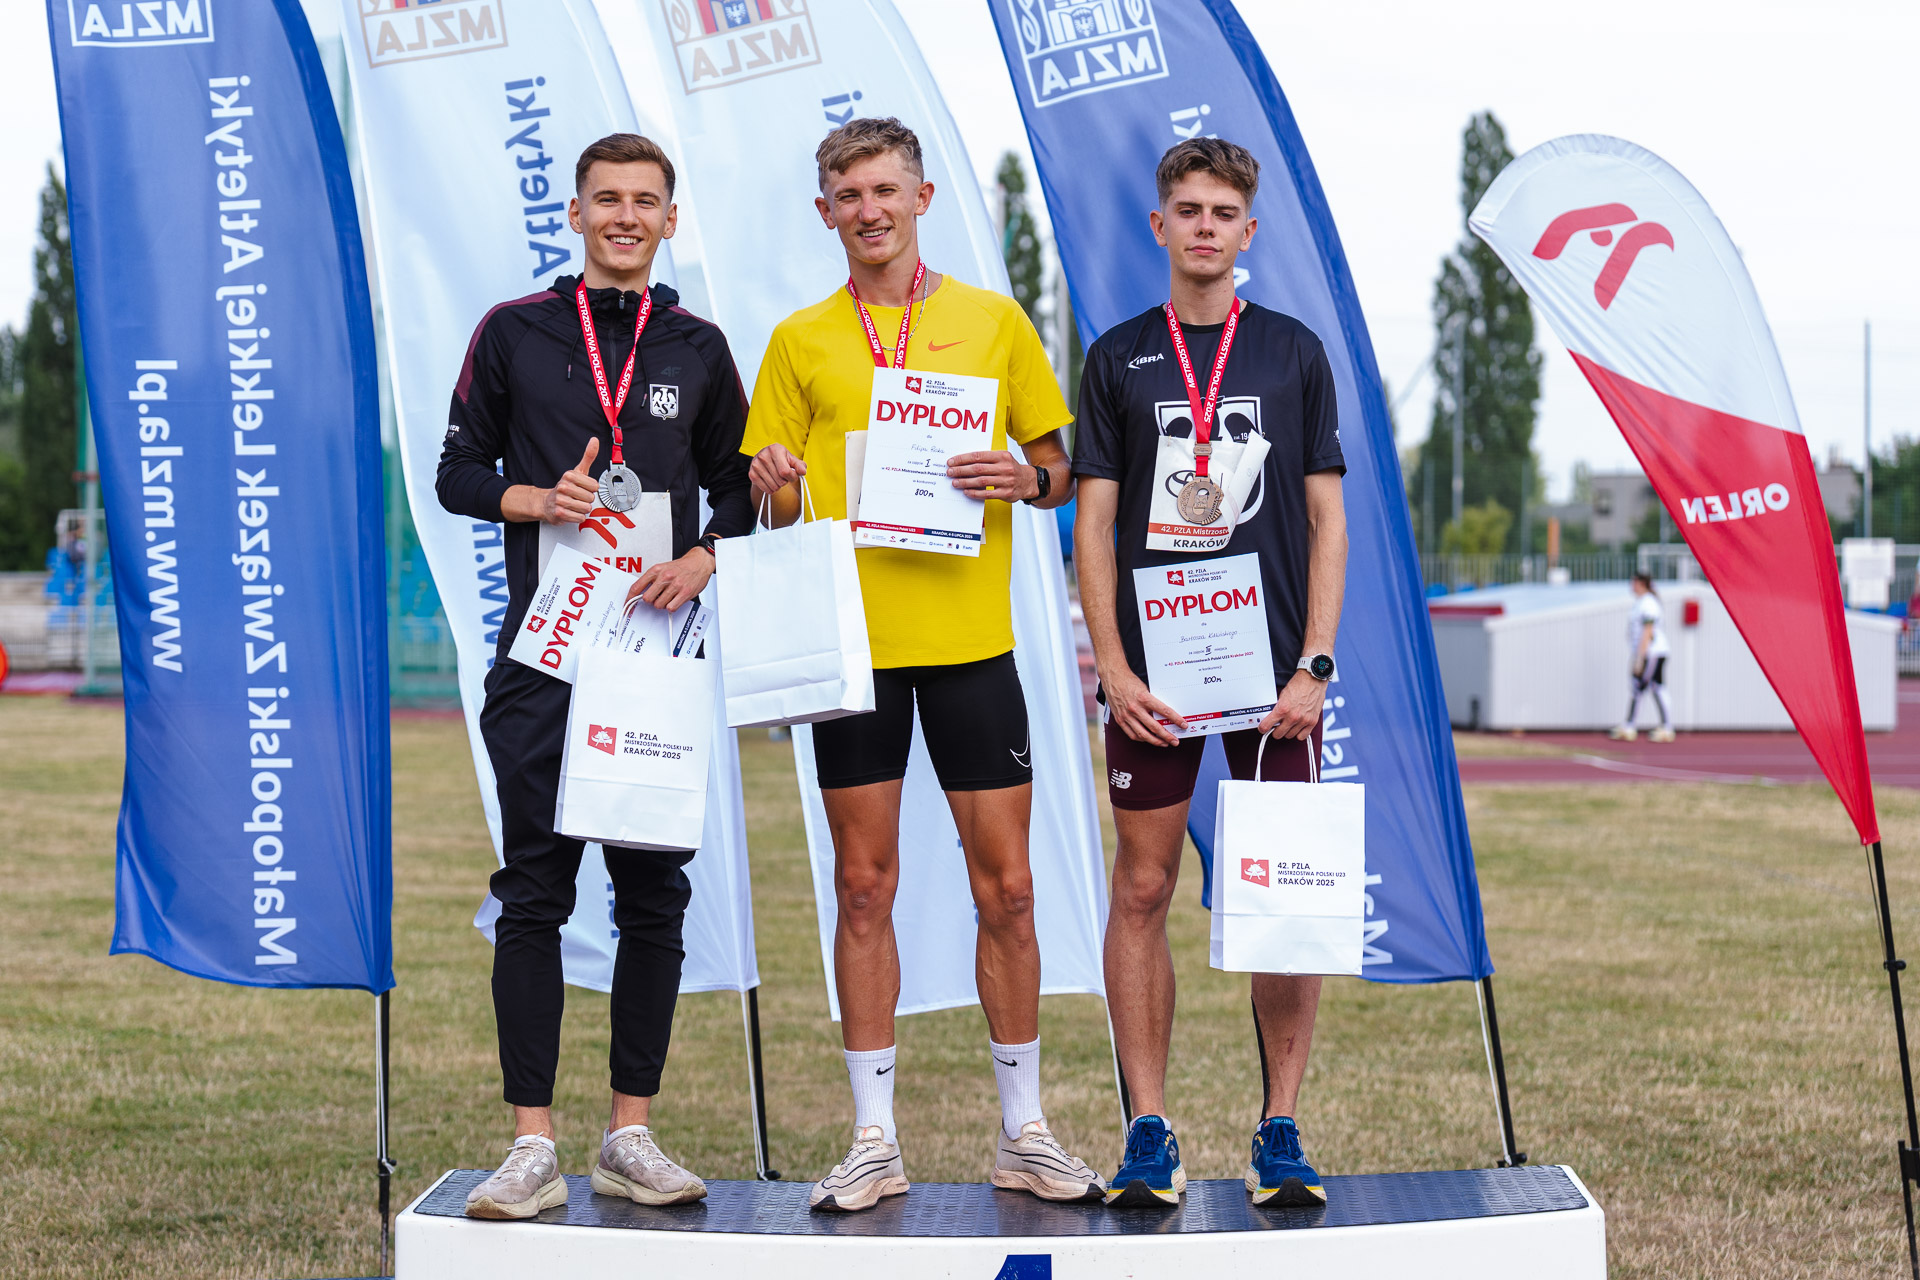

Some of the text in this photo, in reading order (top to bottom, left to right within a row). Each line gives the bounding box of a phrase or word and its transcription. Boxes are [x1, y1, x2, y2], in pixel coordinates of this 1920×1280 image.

[577, 290, 611, 407] MISTRZOSTWA POLSKI 2025
[1173, 332, 1196, 389] MISTRZOSTWA
[1203, 312, 1238, 424] MISTRZOSTWA POLSKI 2025
[876, 399, 988, 433] DYPLOM
[1161, 525, 1173, 533] 42.
[1173, 526, 1192, 535] PZLA
[1173, 537, 1226, 549] KRAKÓW
[1144, 586, 1258, 621] DYPLOM
[539, 561, 602, 670] DYPLOM
[624, 731, 658, 741] 42. PZLA
[624, 739, 662, 748] MISTRZOSTWA
[623, 746, 682, 760] KRAKÓW 2025
[1277, 862, 1311, 870] 42. PZLA
[1277, 876, 1335, 887] KRAKÓW 2025
